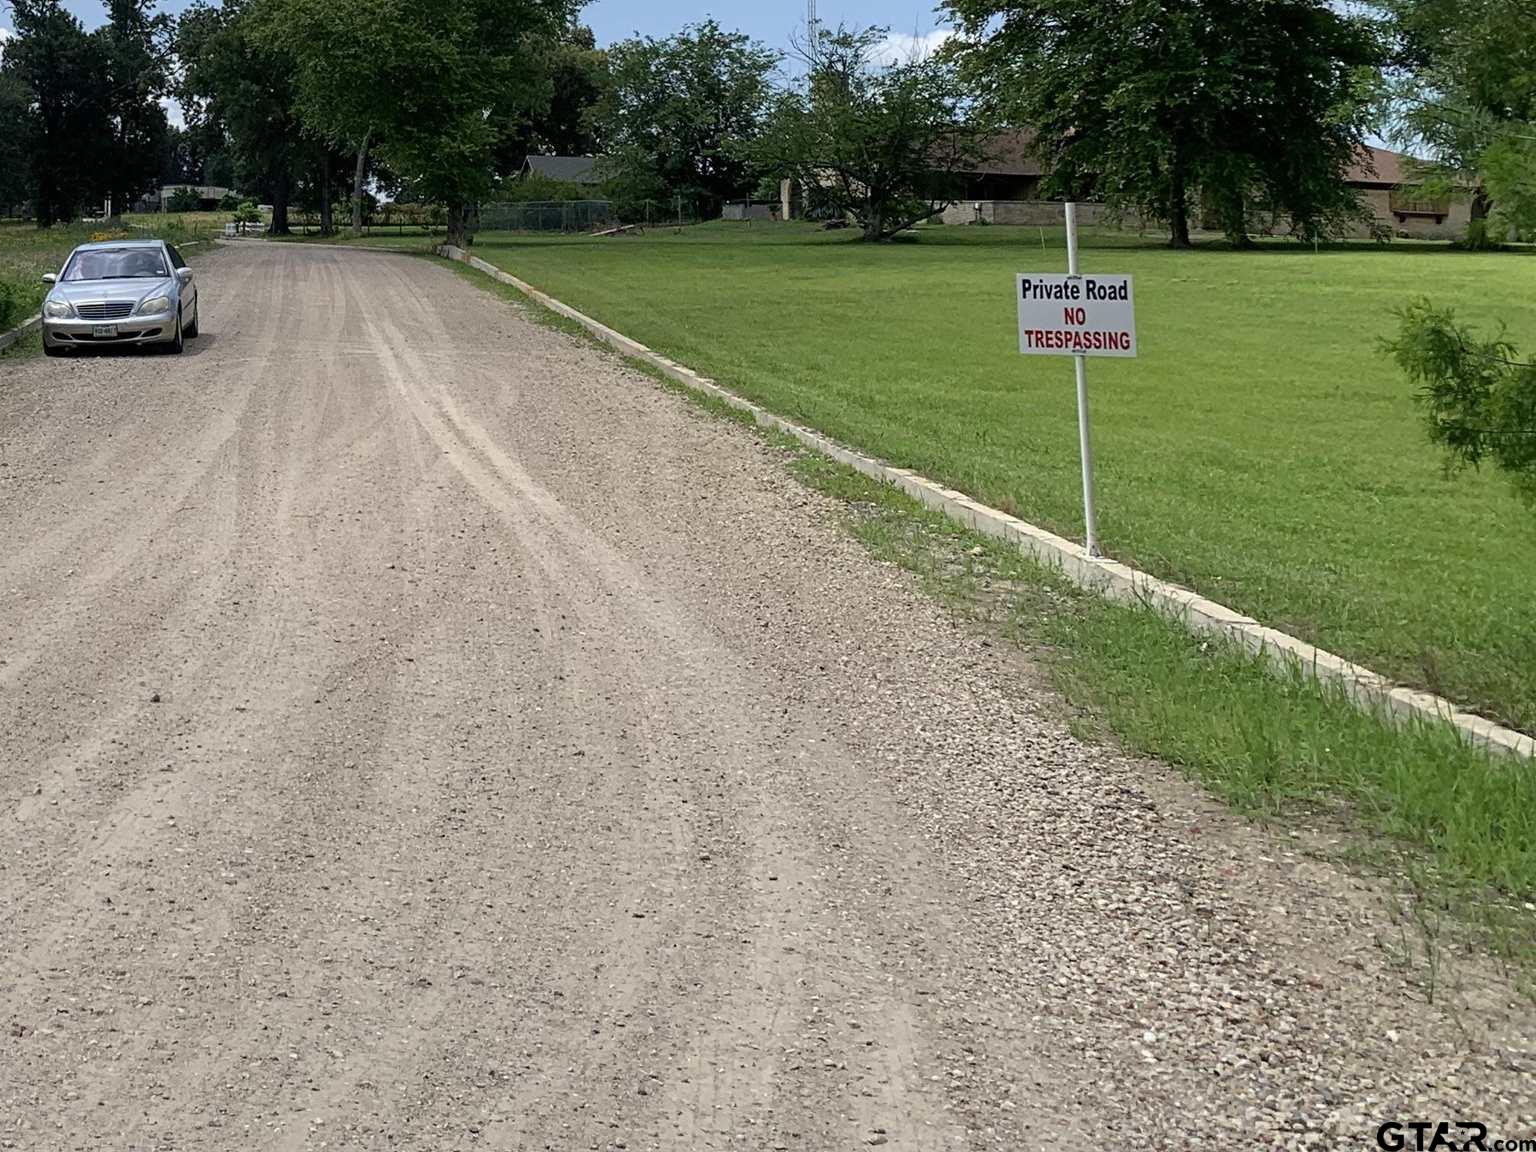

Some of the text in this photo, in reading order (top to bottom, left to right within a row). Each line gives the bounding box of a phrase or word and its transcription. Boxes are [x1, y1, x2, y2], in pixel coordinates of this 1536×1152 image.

[1021, 279, 1129, 300] Private Road
[1064, 307, 1086, 325] NO
[1025, 330, 1130, 350] TRESPASSING
